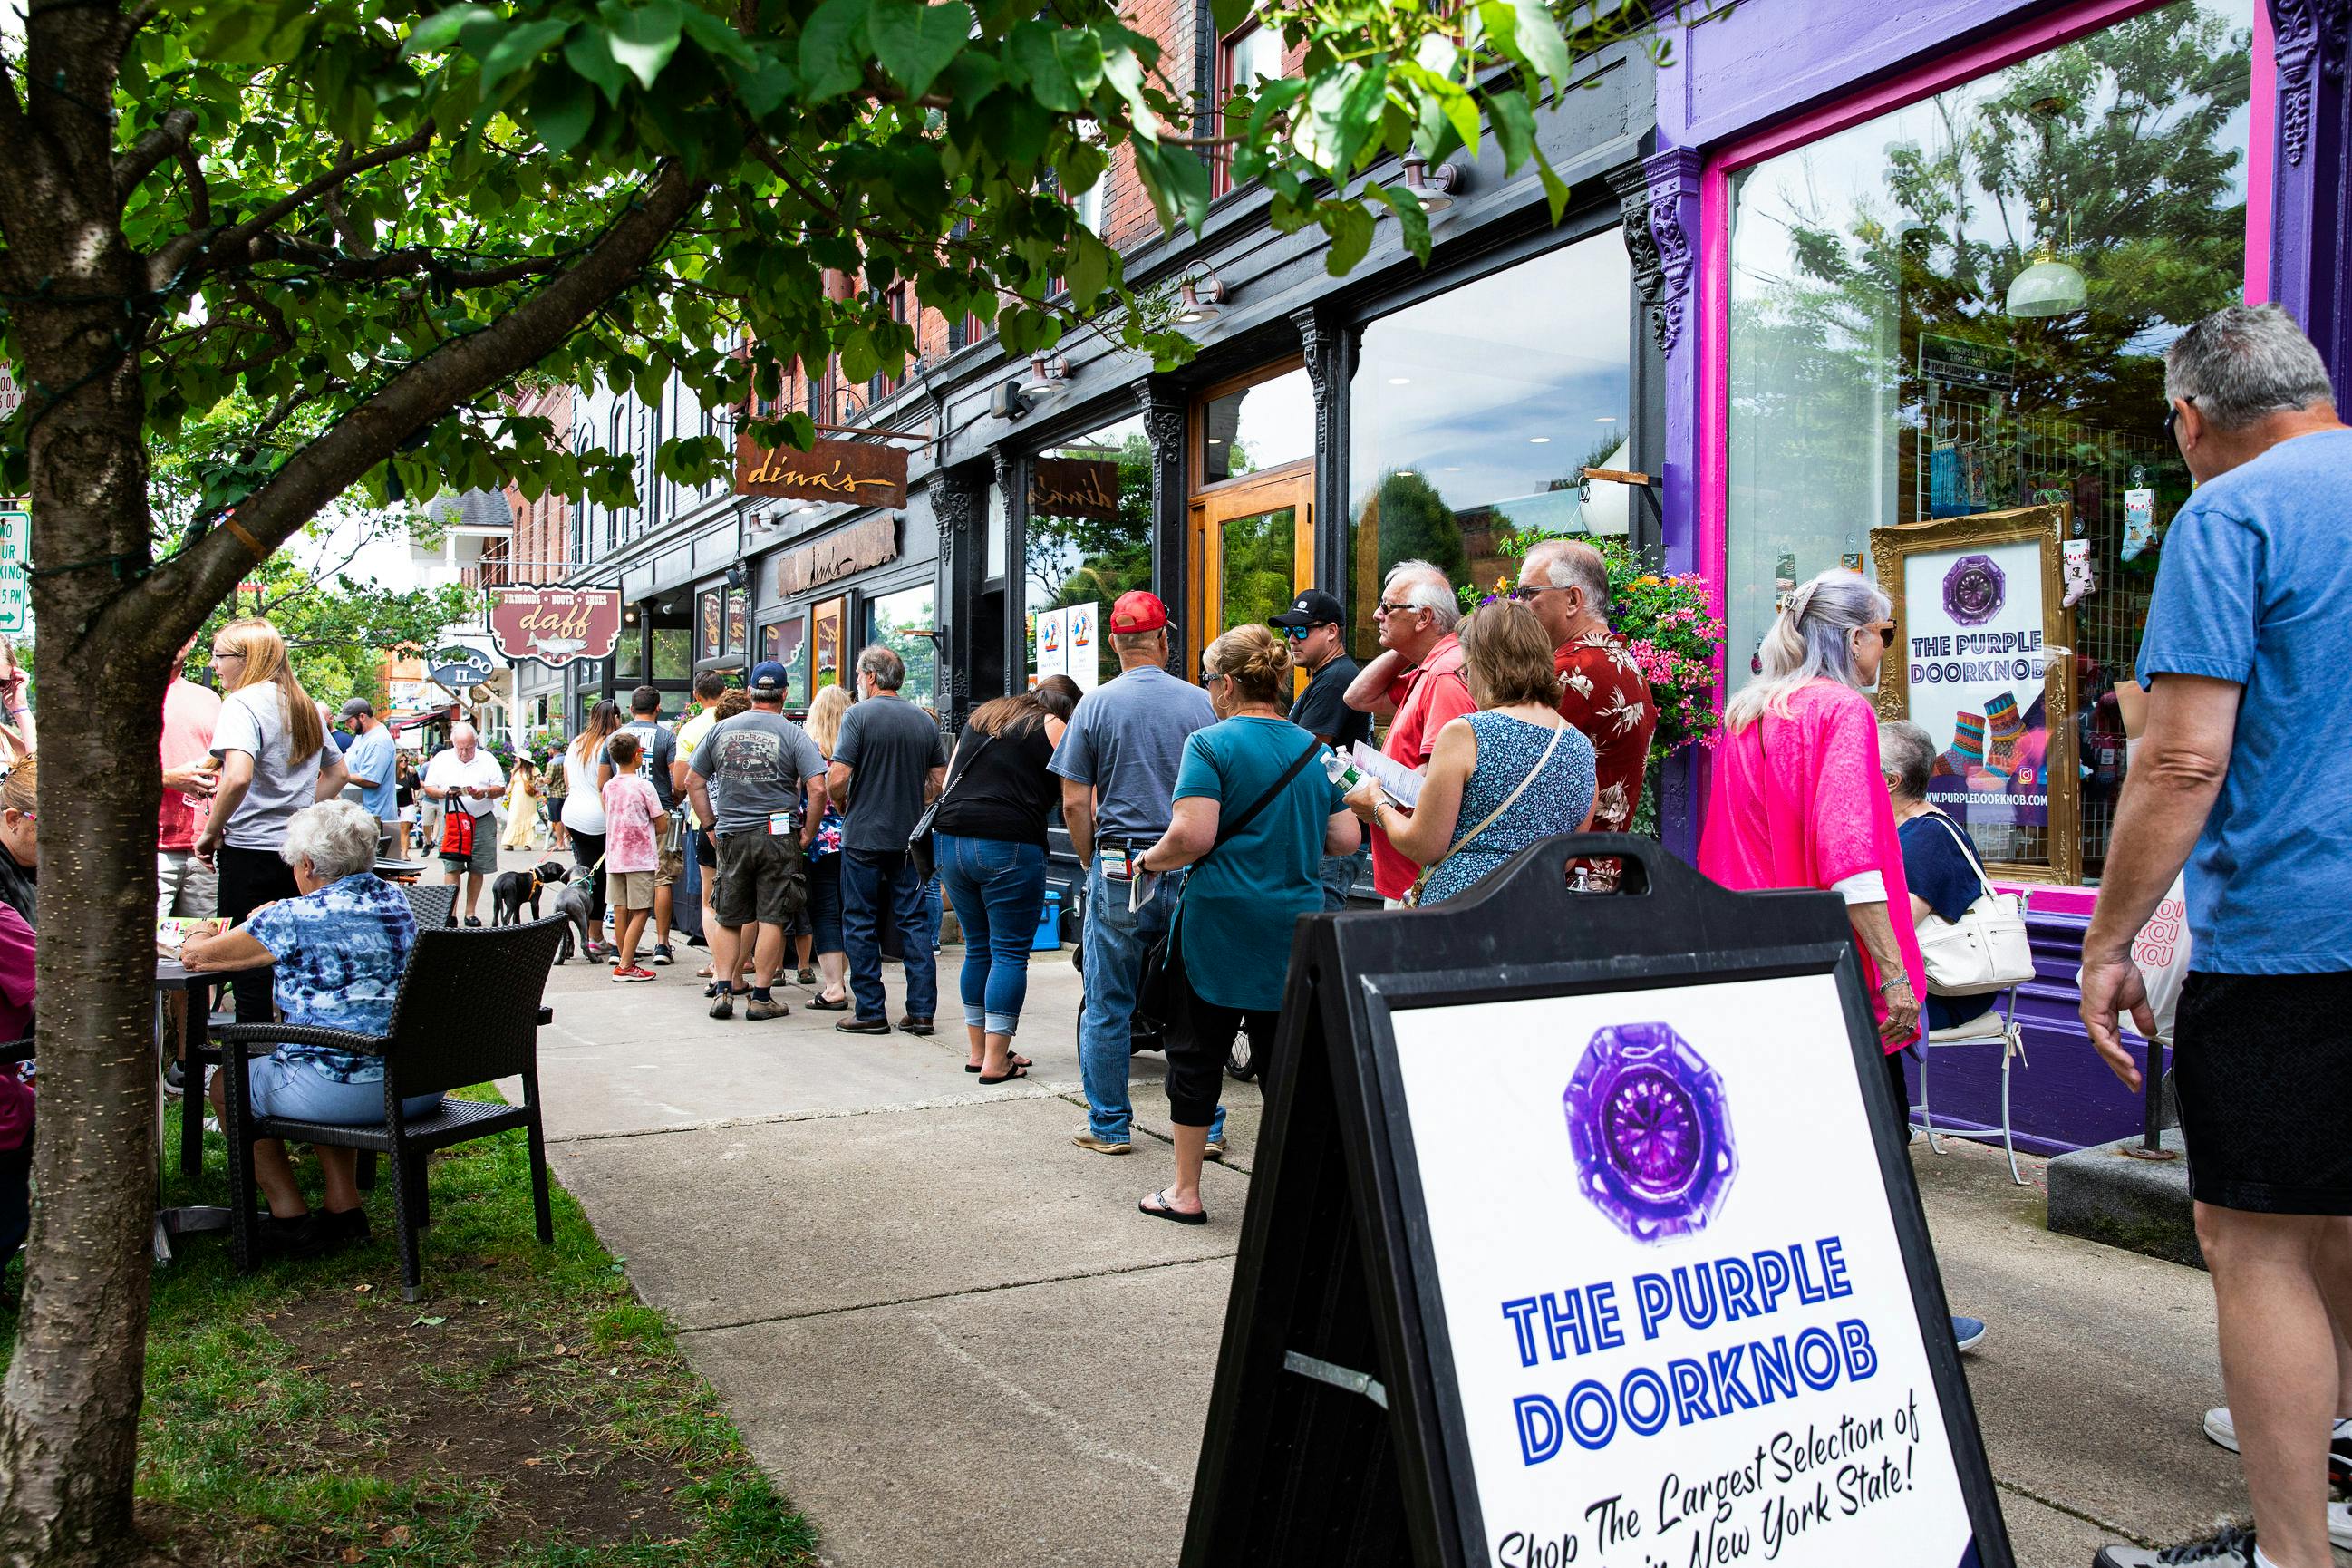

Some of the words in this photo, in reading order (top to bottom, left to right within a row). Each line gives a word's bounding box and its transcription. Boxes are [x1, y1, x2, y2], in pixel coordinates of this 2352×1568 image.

[1931, 363, 1944, 373] THE
[1945, 364, 1970, 376] PURPLE
[748, 448, 896, 492] dina's
[10, 589, 22, 605] PM
[504, 594, 541, 605] DRYGOODS
[552, 594, 575, 605] BOOTS
[585, 595, 608, 605] SHOES
[519, 604, 592, 639] daff
[1912, 635, 1950, 658] THE
[1956, 630, 2042, 656] PURPLE
[1911, 658, 2046, 684] DOORKNOB
[1924, 792, 2048, 806] WW.PURPLEDOORKNOB.COM
[2154, 899, 2185, 922] OU
[2133, 941, 2173, 968] YOU
[1502, 1281, 1625, 1368] THE
[1632, 1236, 1854, 1341] PURPLE
[1513, 1319, 1878, 1466] DOORKNOB
[1584, 1494, 1641, 1556] The
[1657, 1445, 1766, 1535] Largest
[1770, 1413, 1884, 1483] Selection
[1895, 1388, 1920, 1444] of
[1689, 1516, 1751, 1568] New
[1762, 1482, 1832, 1561] York
[1836, 1446, 1914, 1516] State!
